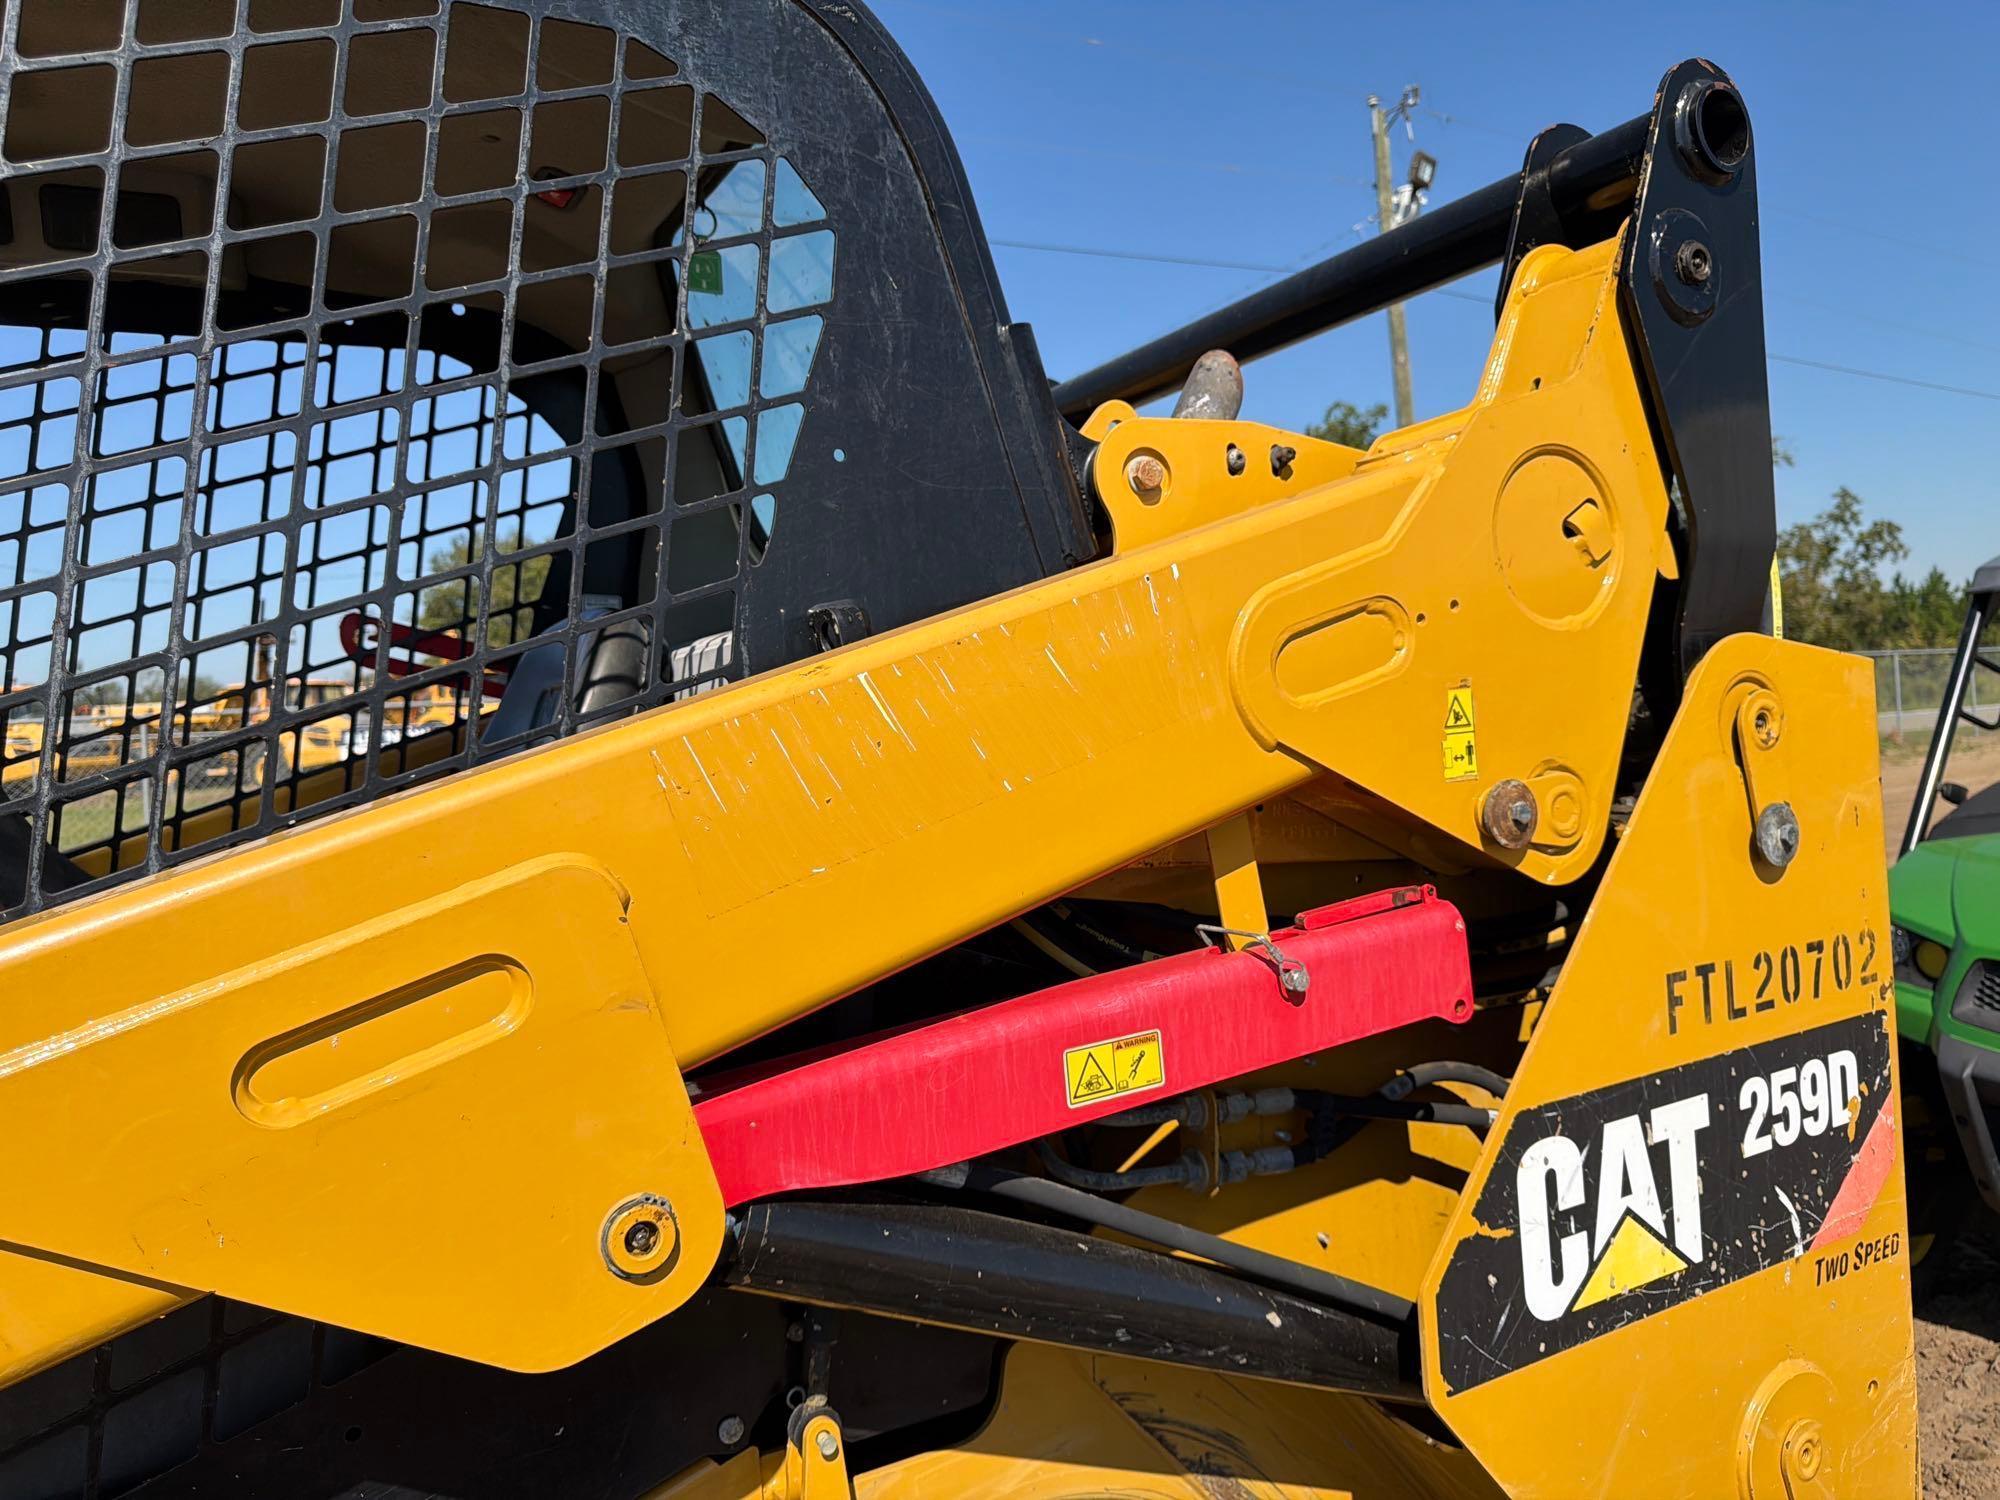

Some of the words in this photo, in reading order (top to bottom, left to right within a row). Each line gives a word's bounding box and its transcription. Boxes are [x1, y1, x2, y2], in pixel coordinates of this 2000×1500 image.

[1666, 928, 1878, 1035] FTL20702
[1123, 1034, 1156, 1048] WARNING
[1739, 1050, 1861, 1159] 259D
[1517, 1093, 1710, 1322] CAT
